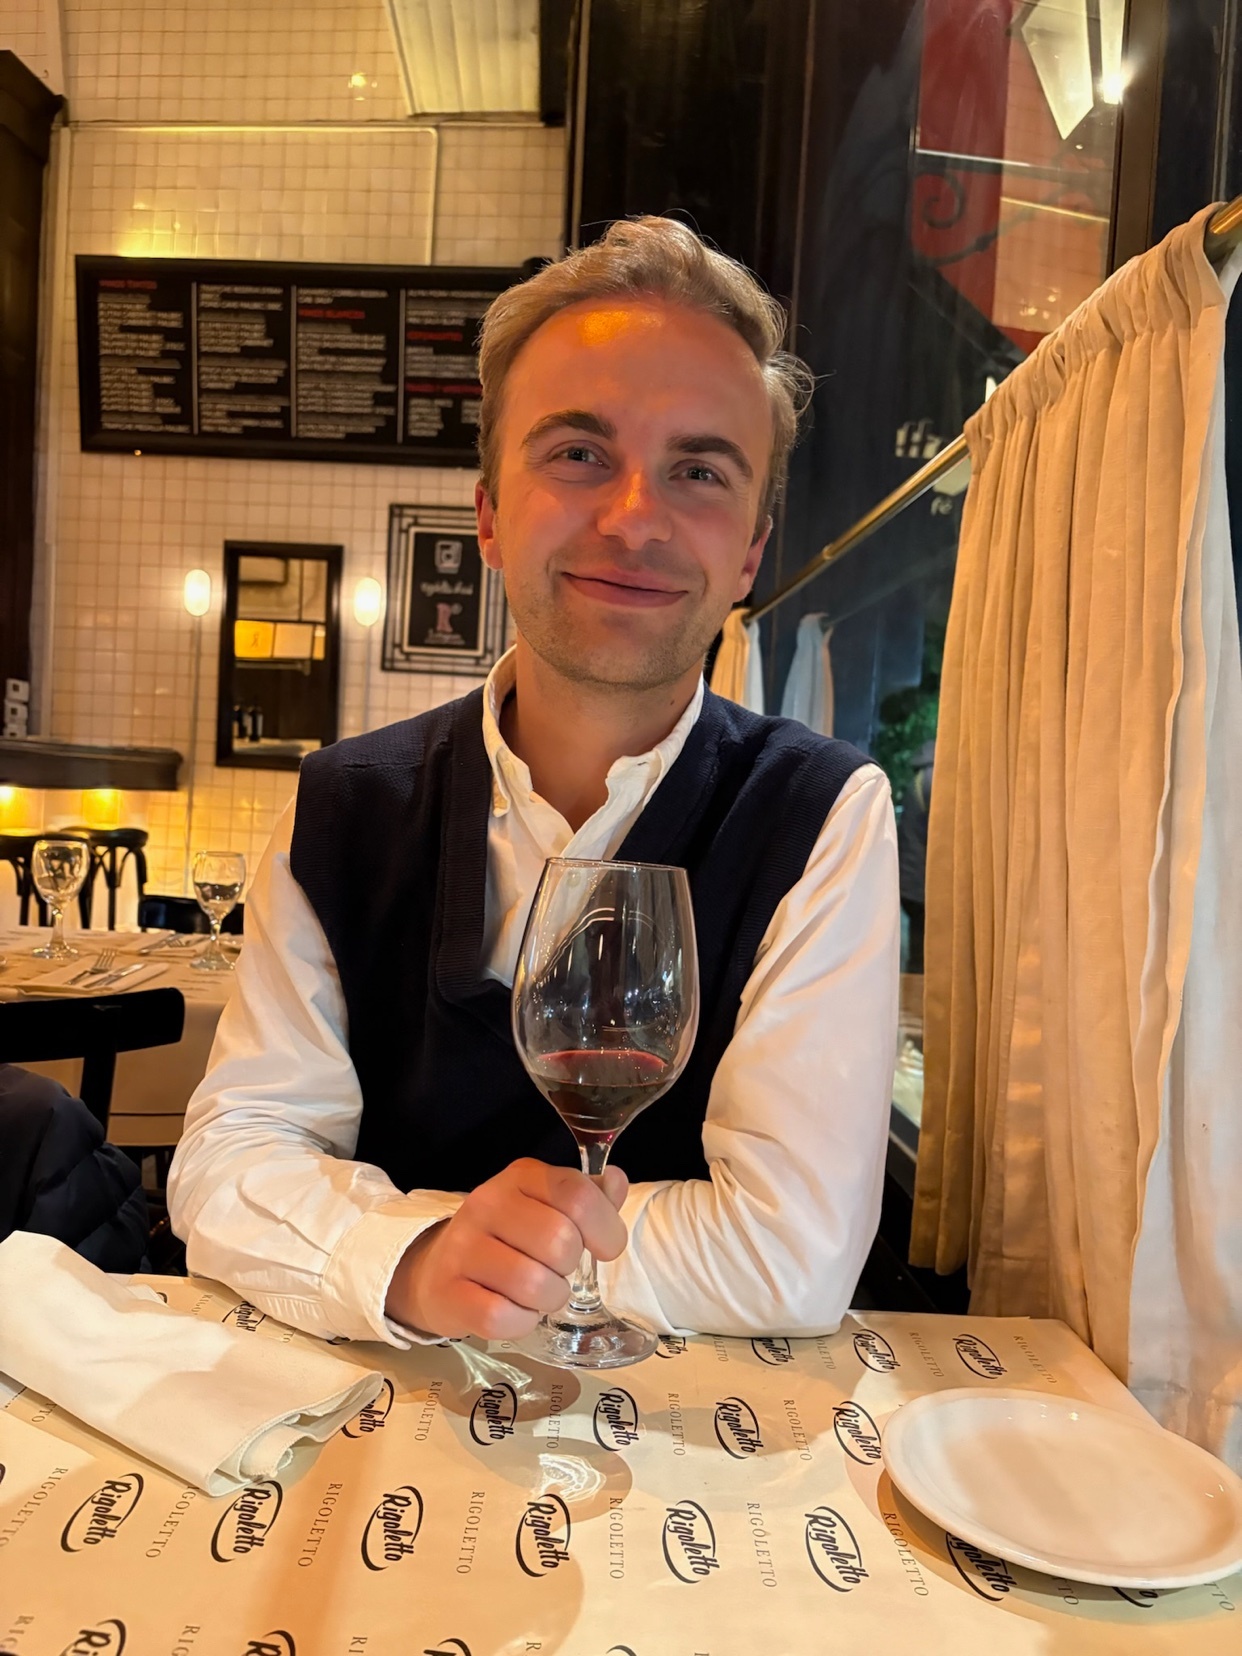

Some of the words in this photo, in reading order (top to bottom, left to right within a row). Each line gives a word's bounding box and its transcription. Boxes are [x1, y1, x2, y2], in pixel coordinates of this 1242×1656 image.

[815, 1338, 836, 1370] OLETTO
[852, 1330, 901, 1372] Rigoletto
[908, 1331, 944, 1378] RIGOLETTO
[953, 1335, 1008, 1378] Rigoletto
[1013, 1335, 1057, 1384] RIGOLETTO
[414, 1381, 443, 1441] RIGOLETTO
[478, 1388, 514, 1440] Rigoletto
[546, 1384, 563, 1449] RIGOLETTO
[598, 1391, 640, 1446] Rigoletto
[668, 1392, 686, 1457] RIGOLETTO
[716, 1400, 765, 1453] Rigoletto
[784, 1399, 813, 1461] RIGOLETTO
[832, 1406, 882, 1460] Rigoletto
[82, 1479, 132, 1545] Rigoletto
[145, 1486, 200, 1558] IGOLETTO
[232, 1487, 272, 1554] Rigoletto
[297, 1483, 343, 1567] RIGOLETTO
[376, 1493, 414, 1562] Rigoletto
[456, 1491, 485, 1574] RIGOLETTO
[523, 1501, 570, 1569] Rigoletto
[609, 1497, 625, 1579] RIGOLETTO
[666, 1507, 720, 1577] Rigoletto
[747, 1502, 777, 1588] RIGOLETTO
[805, 1513, 869, 1585] Rigoletto
[883, 1512, 929, 1597] RIGOLETTO
